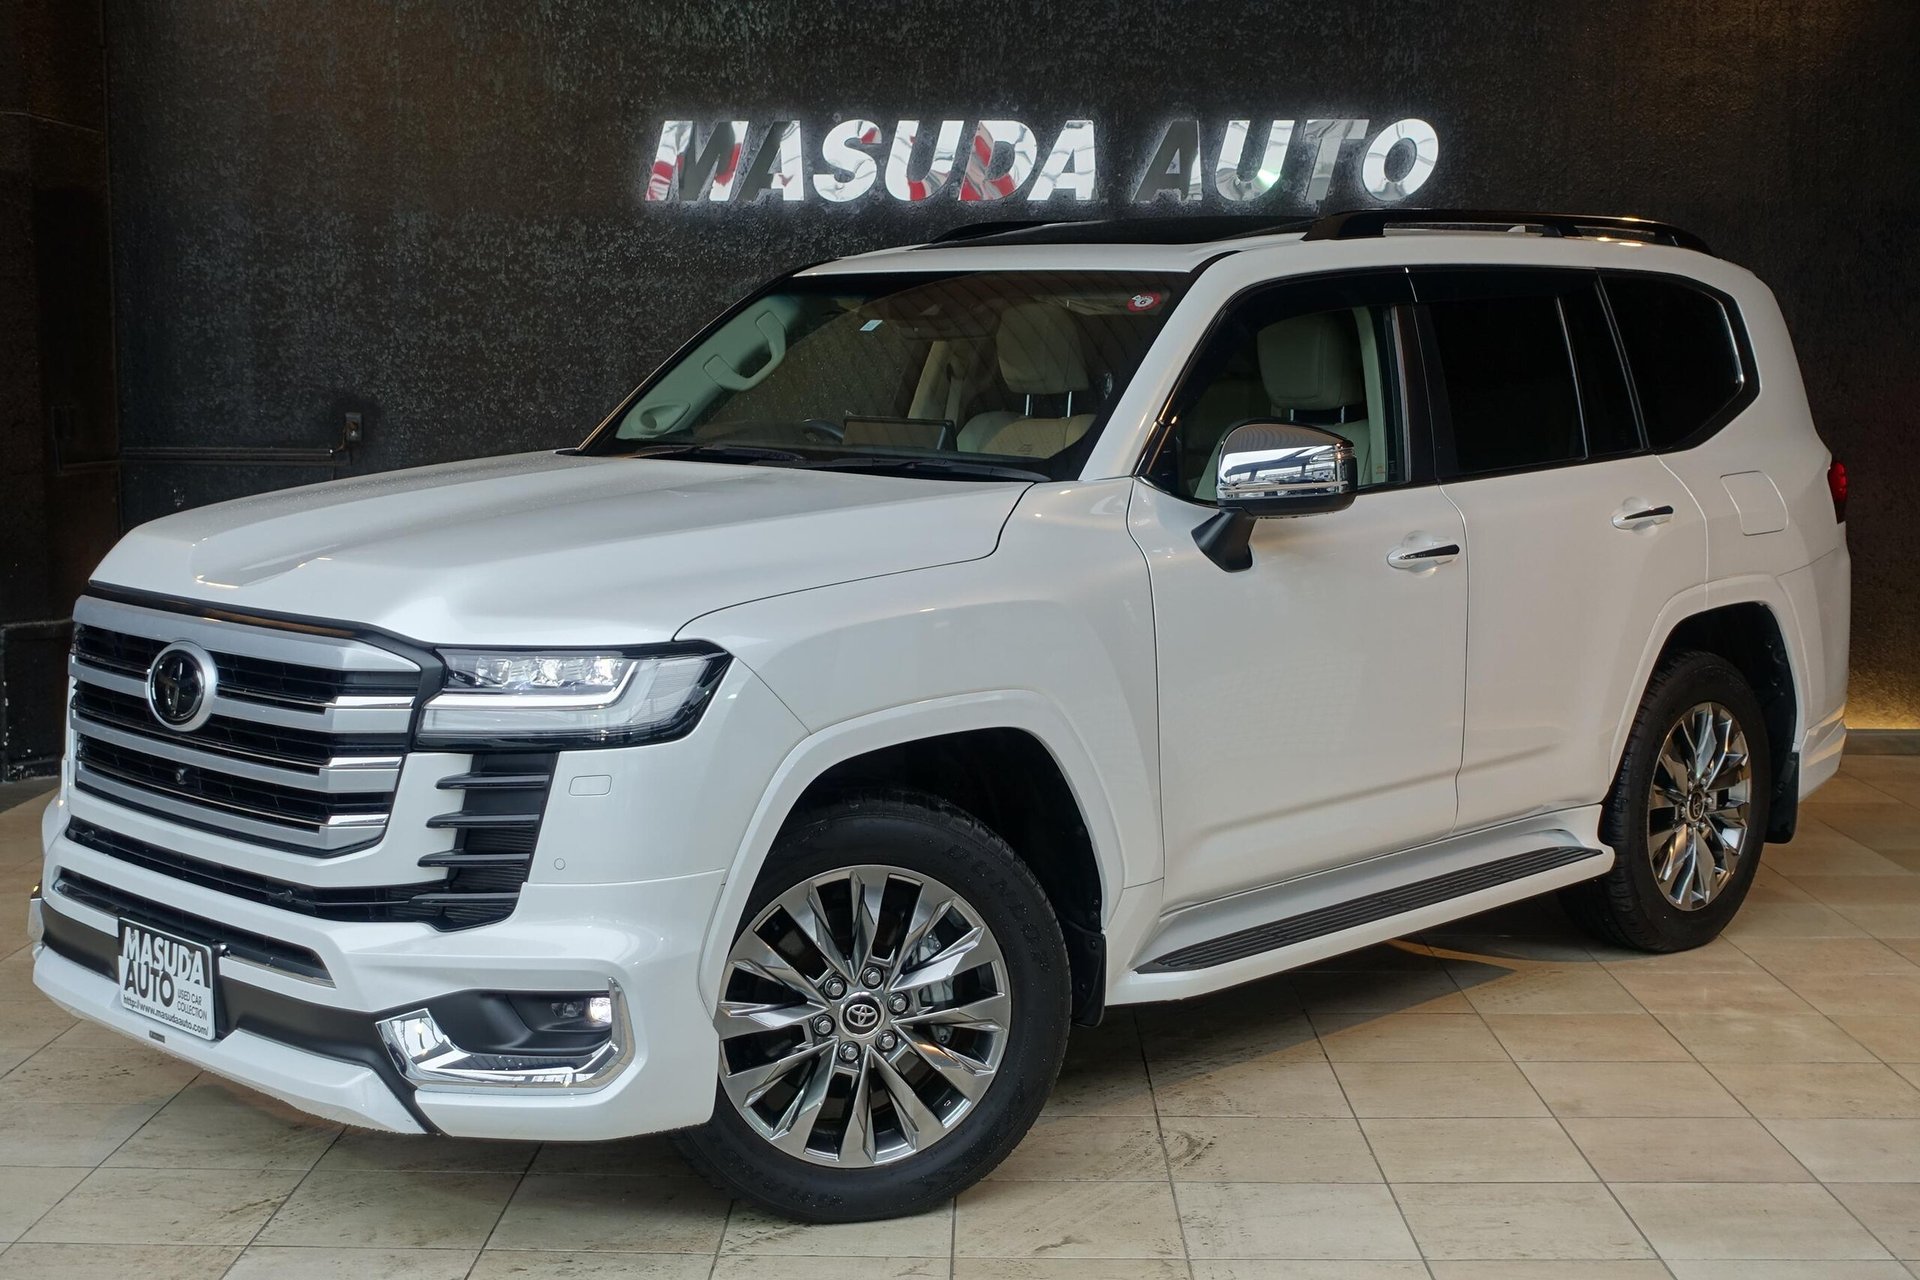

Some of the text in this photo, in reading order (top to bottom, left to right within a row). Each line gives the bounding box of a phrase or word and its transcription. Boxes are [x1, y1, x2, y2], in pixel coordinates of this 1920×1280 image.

[645, 118, 1439, 202] MASUDA AUTO
[123, 926, 206, 987] MASUDA
[124, 959, 174, 1008] AUTO
[177, 988, 202, 1006] USED CAR
[177, 1001, 208, 1021] COLLECTION
